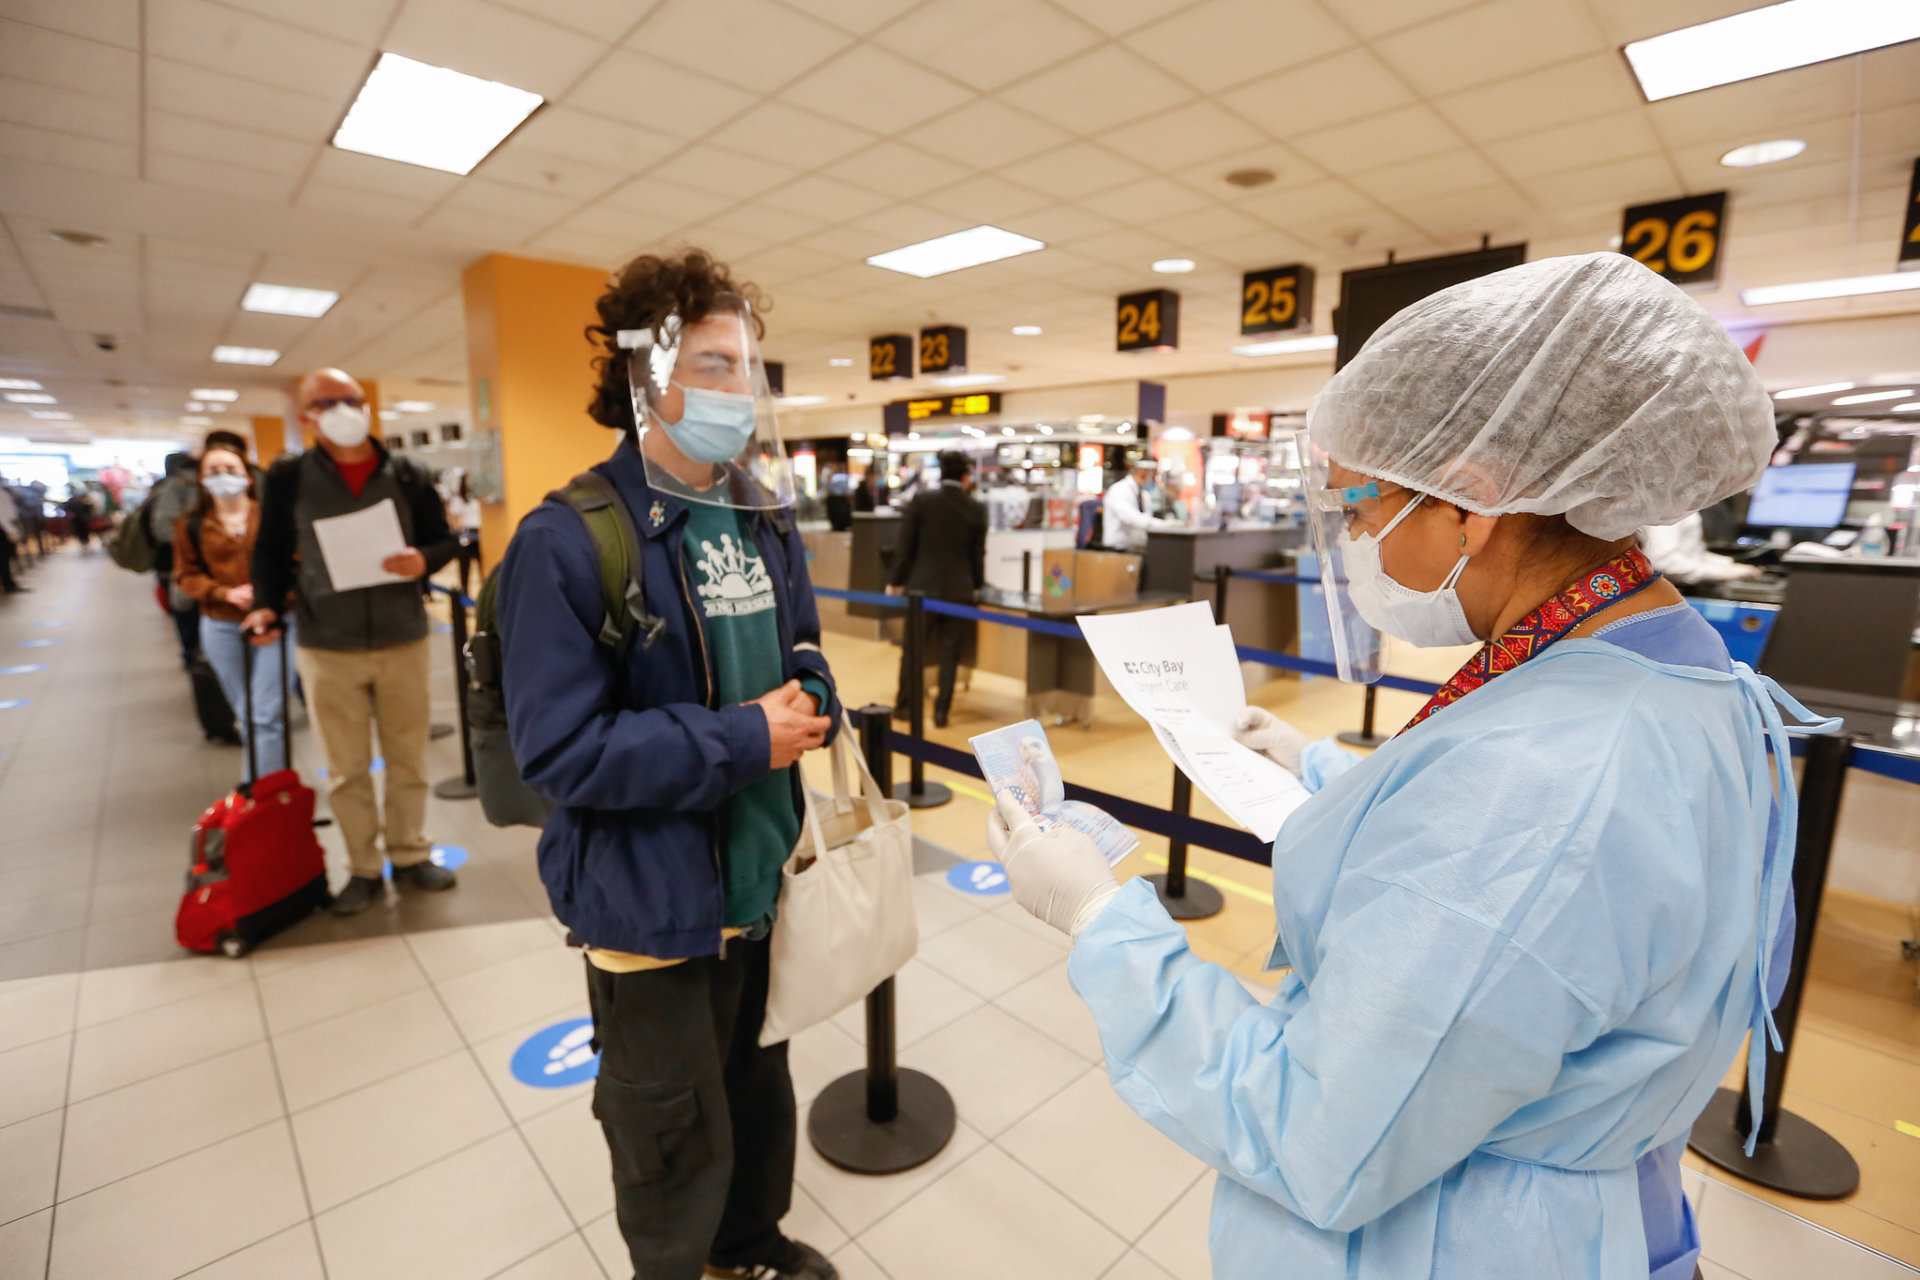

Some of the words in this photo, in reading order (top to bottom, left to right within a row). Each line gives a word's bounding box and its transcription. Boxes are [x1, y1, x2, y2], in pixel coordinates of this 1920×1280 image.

[1625, 210, 1717, 273] 26
[1244, 277, 1296, 326] 25
[1119, 300, 1160, 343] 24
[871, 342, 896, 374] 22
[921, 333, 949, 367] 23
[1140, 661, 1161, 677] City
[1162, 660, 1184, 675] Bay
[1166, 679, 1188, 692] Care
